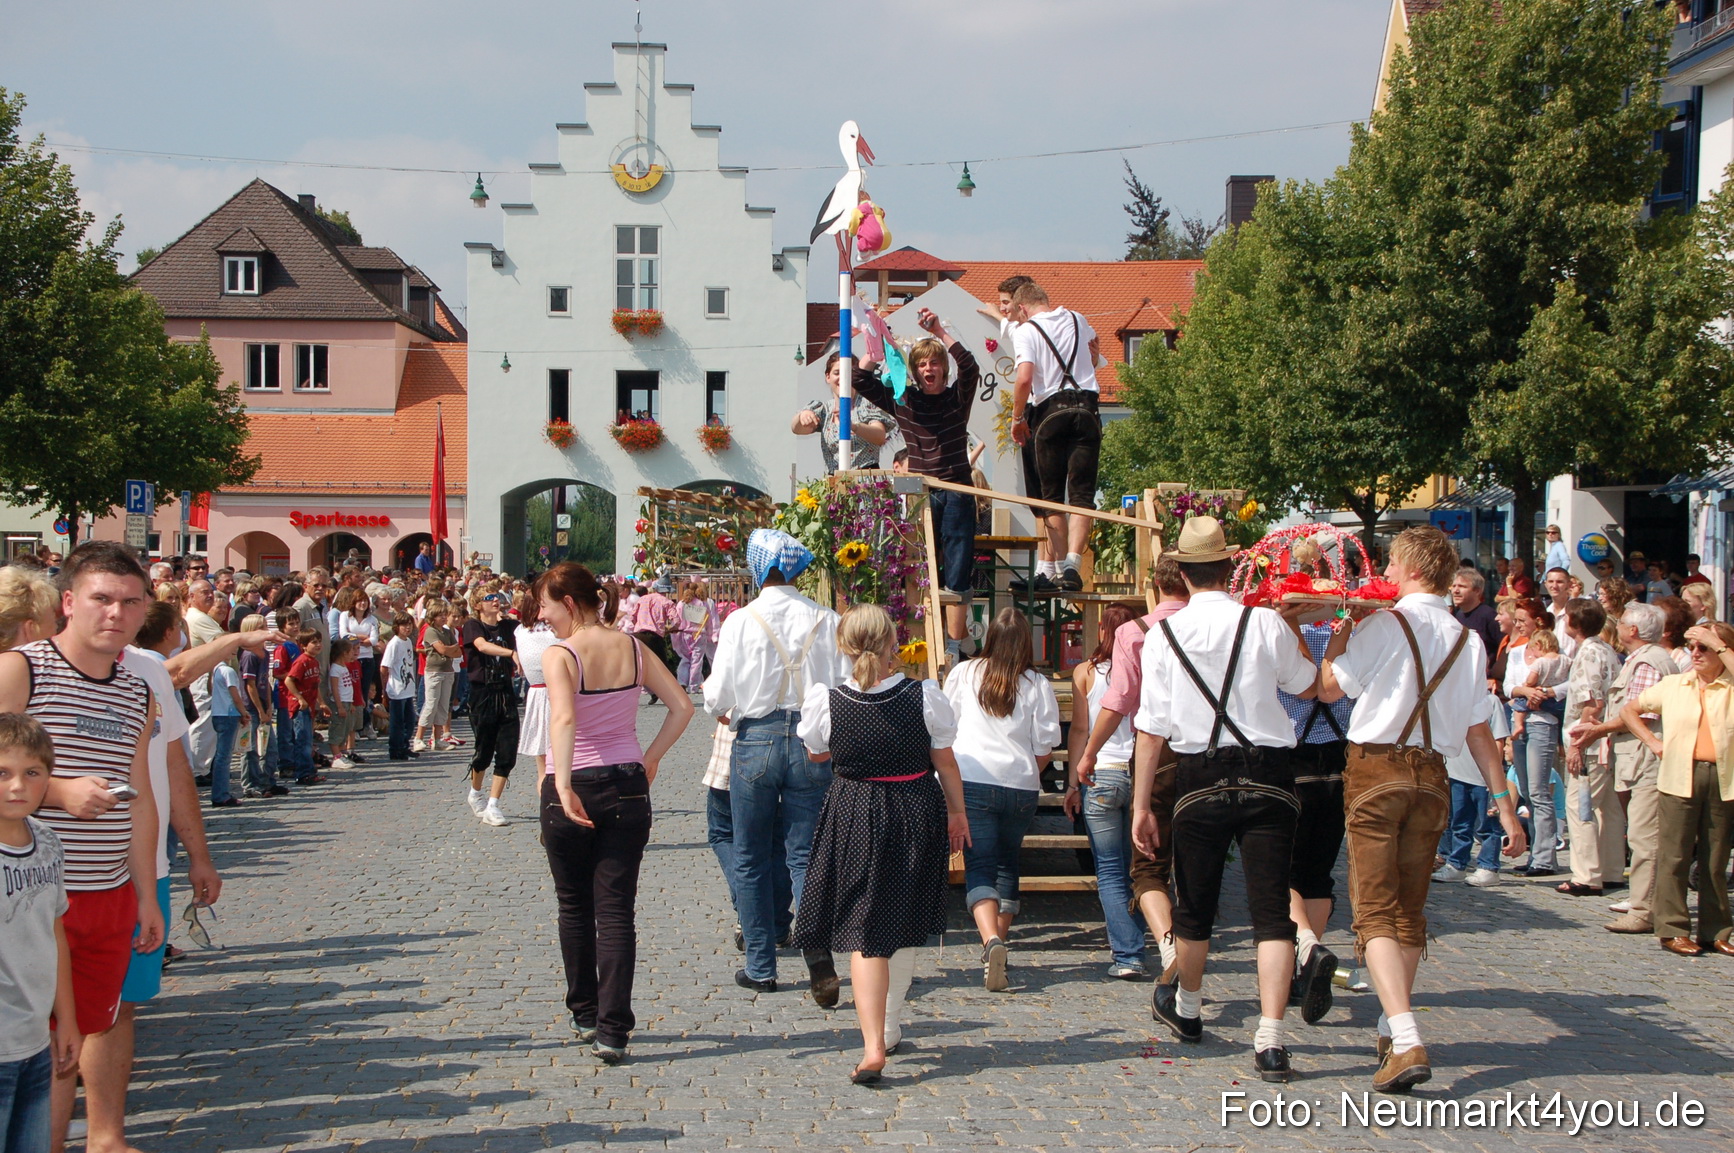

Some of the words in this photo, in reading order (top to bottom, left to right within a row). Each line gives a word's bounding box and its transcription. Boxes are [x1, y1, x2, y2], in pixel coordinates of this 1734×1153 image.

[131, 484, 141, 509] P
[290, 511, 390, 529] Sparkasse
[1581, 543, 1608, 551] Thomas
[1590, 549, 1607, 557] Cook
[76, 715, 123, 740] PUMA
